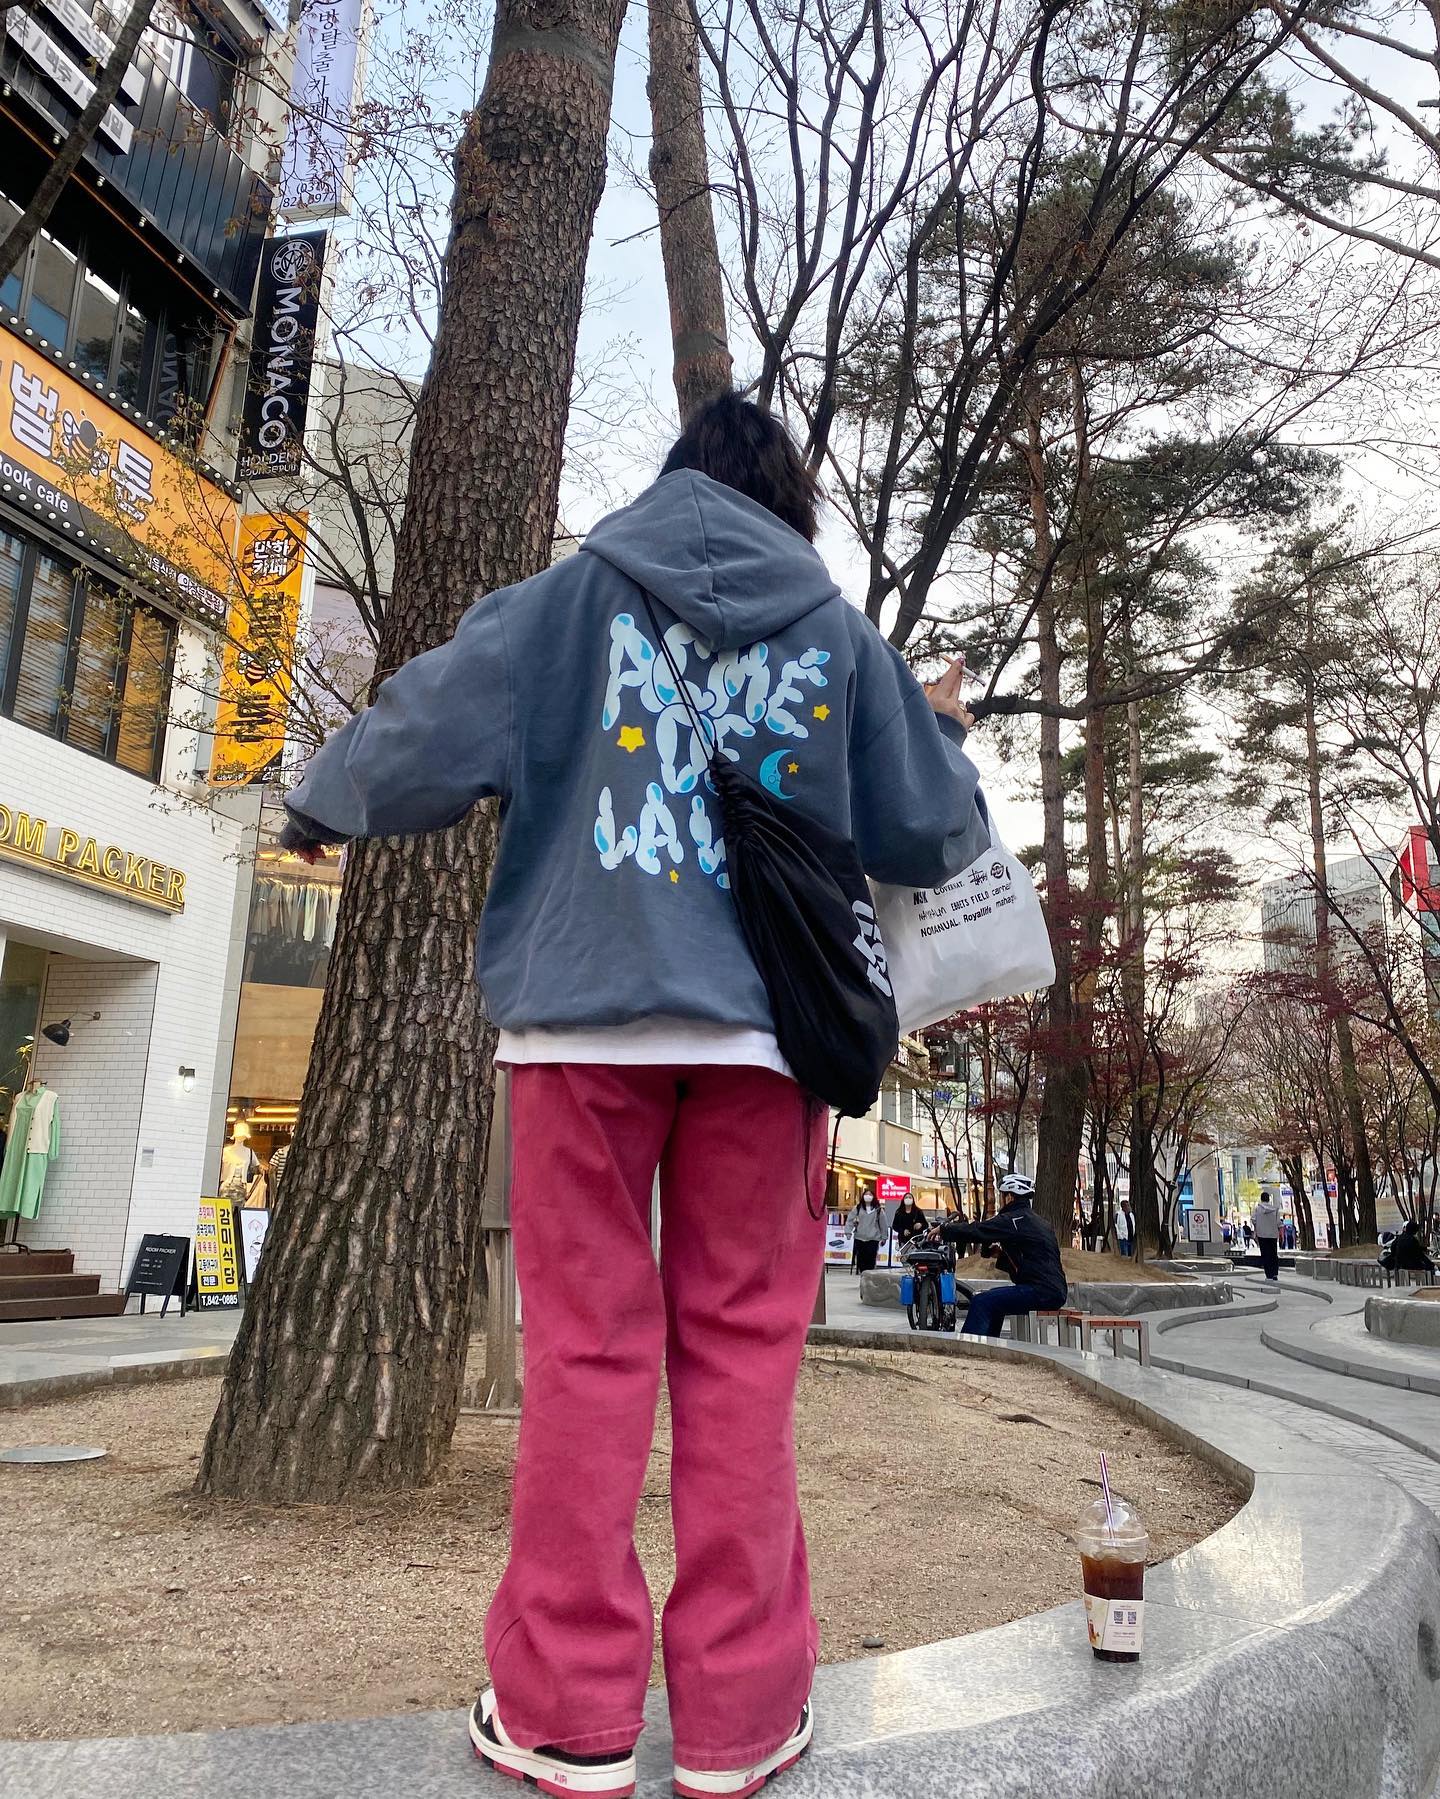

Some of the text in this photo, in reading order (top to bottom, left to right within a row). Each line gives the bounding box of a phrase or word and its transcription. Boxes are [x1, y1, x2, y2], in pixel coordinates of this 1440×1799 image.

[313, 8, 341, 73] 방탈출
[258, 286, 302, 448] MONACO
[36, 484, 69, 513] cafe
[251, 557, 288, 577] 카페
[254, 538, 289, 559] 만화
[602, 613, 831, 738] ACME
[594, 781, 685, 876] LA
[57, 827, 188, 903] PACKER
[970, 890, 989, 905] FIELD
[219, 1208, 236, 1285] 감미식당
